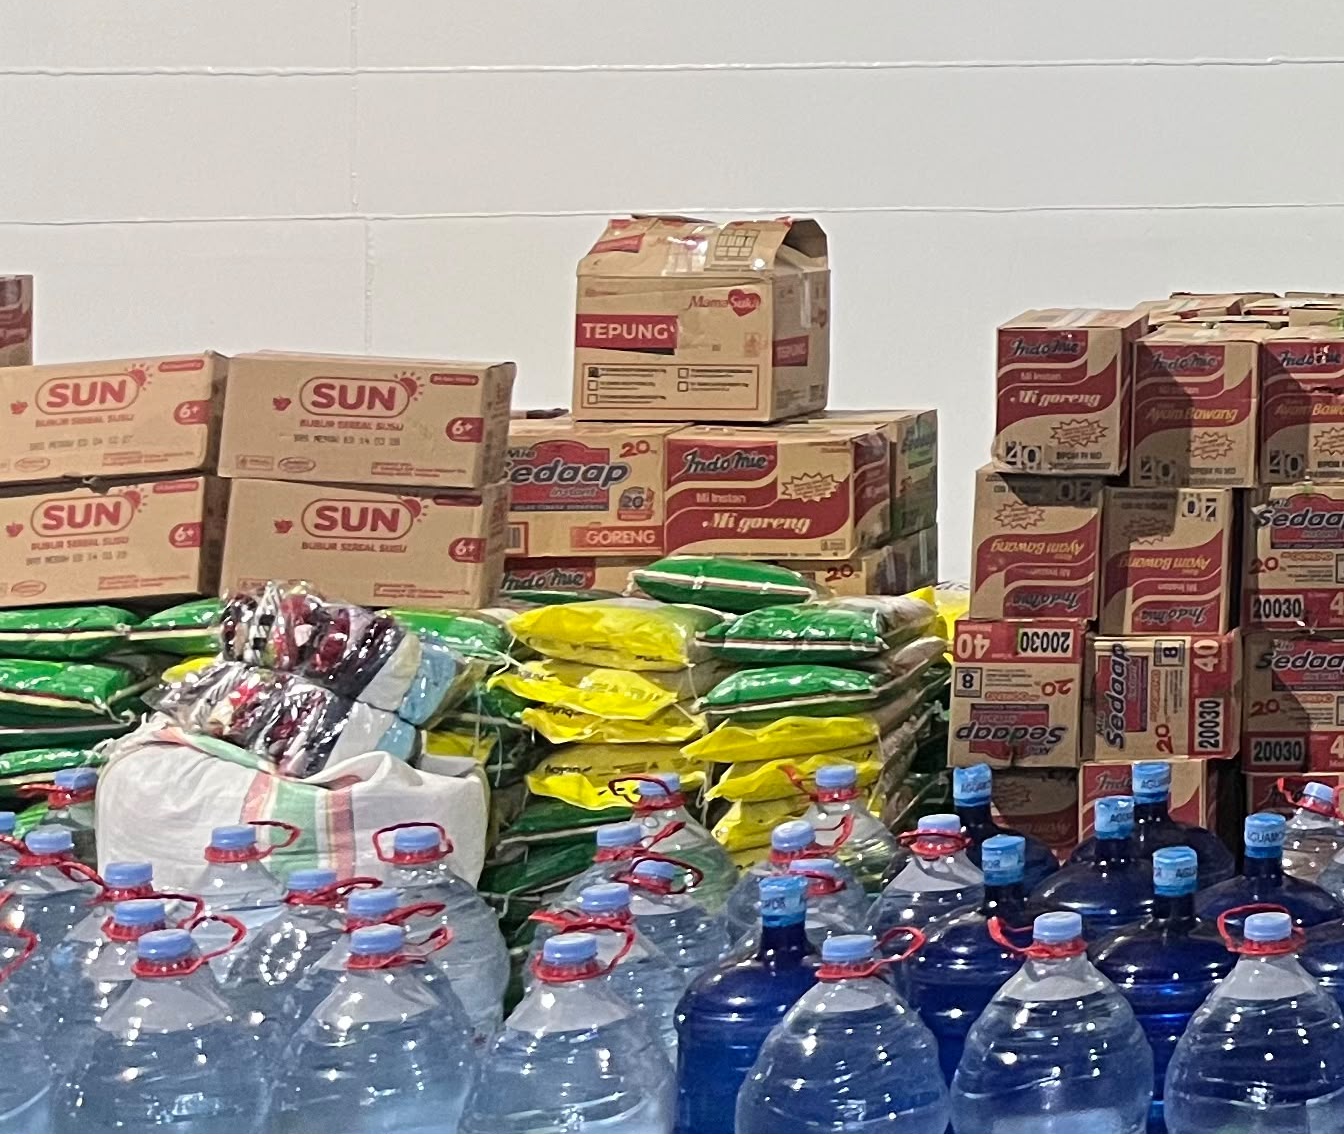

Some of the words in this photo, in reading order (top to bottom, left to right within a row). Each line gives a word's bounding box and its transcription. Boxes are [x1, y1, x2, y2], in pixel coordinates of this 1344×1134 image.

[582, 322, 669, 340] TEPUNG
[46, 379, 127, 408] SUN
[310, 382, 397, 411] SUN
[1184, 407, 1239, 423] Bawang
[619, 440, 650, 458] 20
[42, 501, 122, 530] SUN
[313, 505, 400, 533] SUN
[702, 512, 736, 530] Mi
[737, 516, 811, 534] goreng
[586, 529, 656, 544] GORENG
[825, 564, 854, 582] 20
[1253, 597, 1303, 619] 20030
[956, 633, 991, 659] 40
[1019, 631, 1071, 653] 20030
[1194, 638, 1221, 672] 40
[962, 673, 975, 689] 8
[1042, 677, 1075, 697] 20
[1104, 642, 1131, 751] Sedaap
[1251, 698, 1281, 716] 20
[956, 721, 1068, 745] Sedaap
[1198, 699, 1222, 750] 20030
[1253, 741, 1303, 762] 20030
